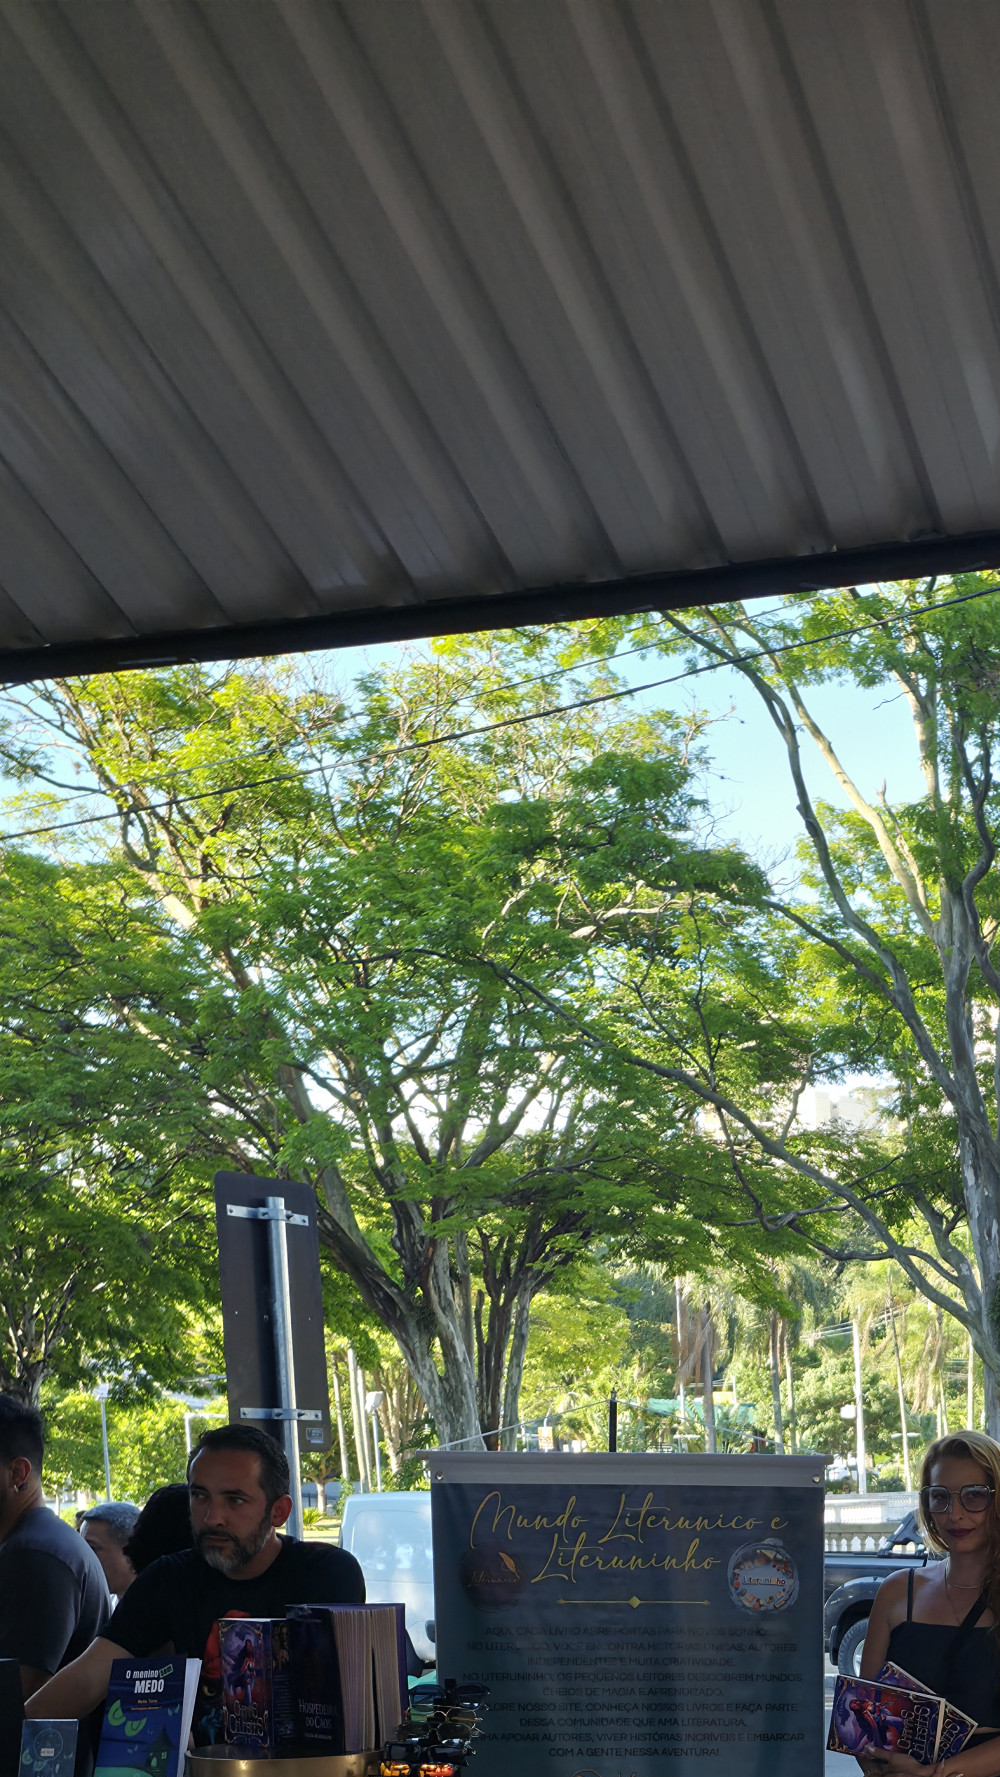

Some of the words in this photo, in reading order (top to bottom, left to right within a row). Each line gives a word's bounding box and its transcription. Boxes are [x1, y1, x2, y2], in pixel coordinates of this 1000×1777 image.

[471, 1491, 589, 1549] Mundo
[598, 1492, 766, 1544] Literunico
[770, 1514, 788, 1530] e
[532, 1533, 721, 1583] Literuninho
[748, 1643, 797, 1653] AUTORES
[527, 1656, 617, 1666] INDEPENDENTES
[629, 1656, 660, 1667] MUITA
[126, 1670, 131, 1679] O
[133, 1668, 159, 1679] menino
[463, 1671, 480, 1681] NO
[557, 1672, 573, 1681] OS
[574, 1672, 634, 1683] PEQUENOS
[637, 1672, 686, 1682] LEITORES
[687, 1672, 754, 1682] DESCOBREM
[756, 1672, 802, 1682] MUNDOS
[134, 1679, 165, 1693] MEDO
[542, 1687, 583, 1696] CHEIOS
[585, 1687, 600, 1696] DE
[601, 1687, 636, 1697] MAGIA
[639, 1687, 646, 1697] E
[518, 1703, 557, 1712] NOSSO
[559, 1703, 583, 1713] SITE,
[585, 1703, 639, 1715] CONHEÇA
[641, 1703, 685, 1712] NOSSOS
[686, 1703, 724, 1712] LIVROS
[726, 1703, 734, 1712] E
[735, 1703, 763, 1715] FAÇA
[765, 1703, 799, 1712] PARTE
[520, 1717, 555, 1727] DESSA
[557, 1717, 632, 1727] COMUNIDADE
[633, 1717, 655, 1728] QUE
[657, 1717, 680, 1727] AMA
[501, 1732, 539, 1742] APOIAR
[541, 1732, 595, 1743] AUTORES,
[596, 1733, 627, 1742] VIVER
[629, 1730, 682, 1742] HISTÓRIAS
[685, 1730, 736, 1742] INCRÍVEIS
[737, 1733, 745, 1742] E
[747, 1733, 805, 1742] EMBARCAR
[549, 1748, 574, 1758] COM
[576, 1748, 583, 1758] A
[585, 1748, 622, 1758] GENTE
[624, 1748, 658, 1758] NESSA
[660, 1748, 720, 1758] AVENTURA!
